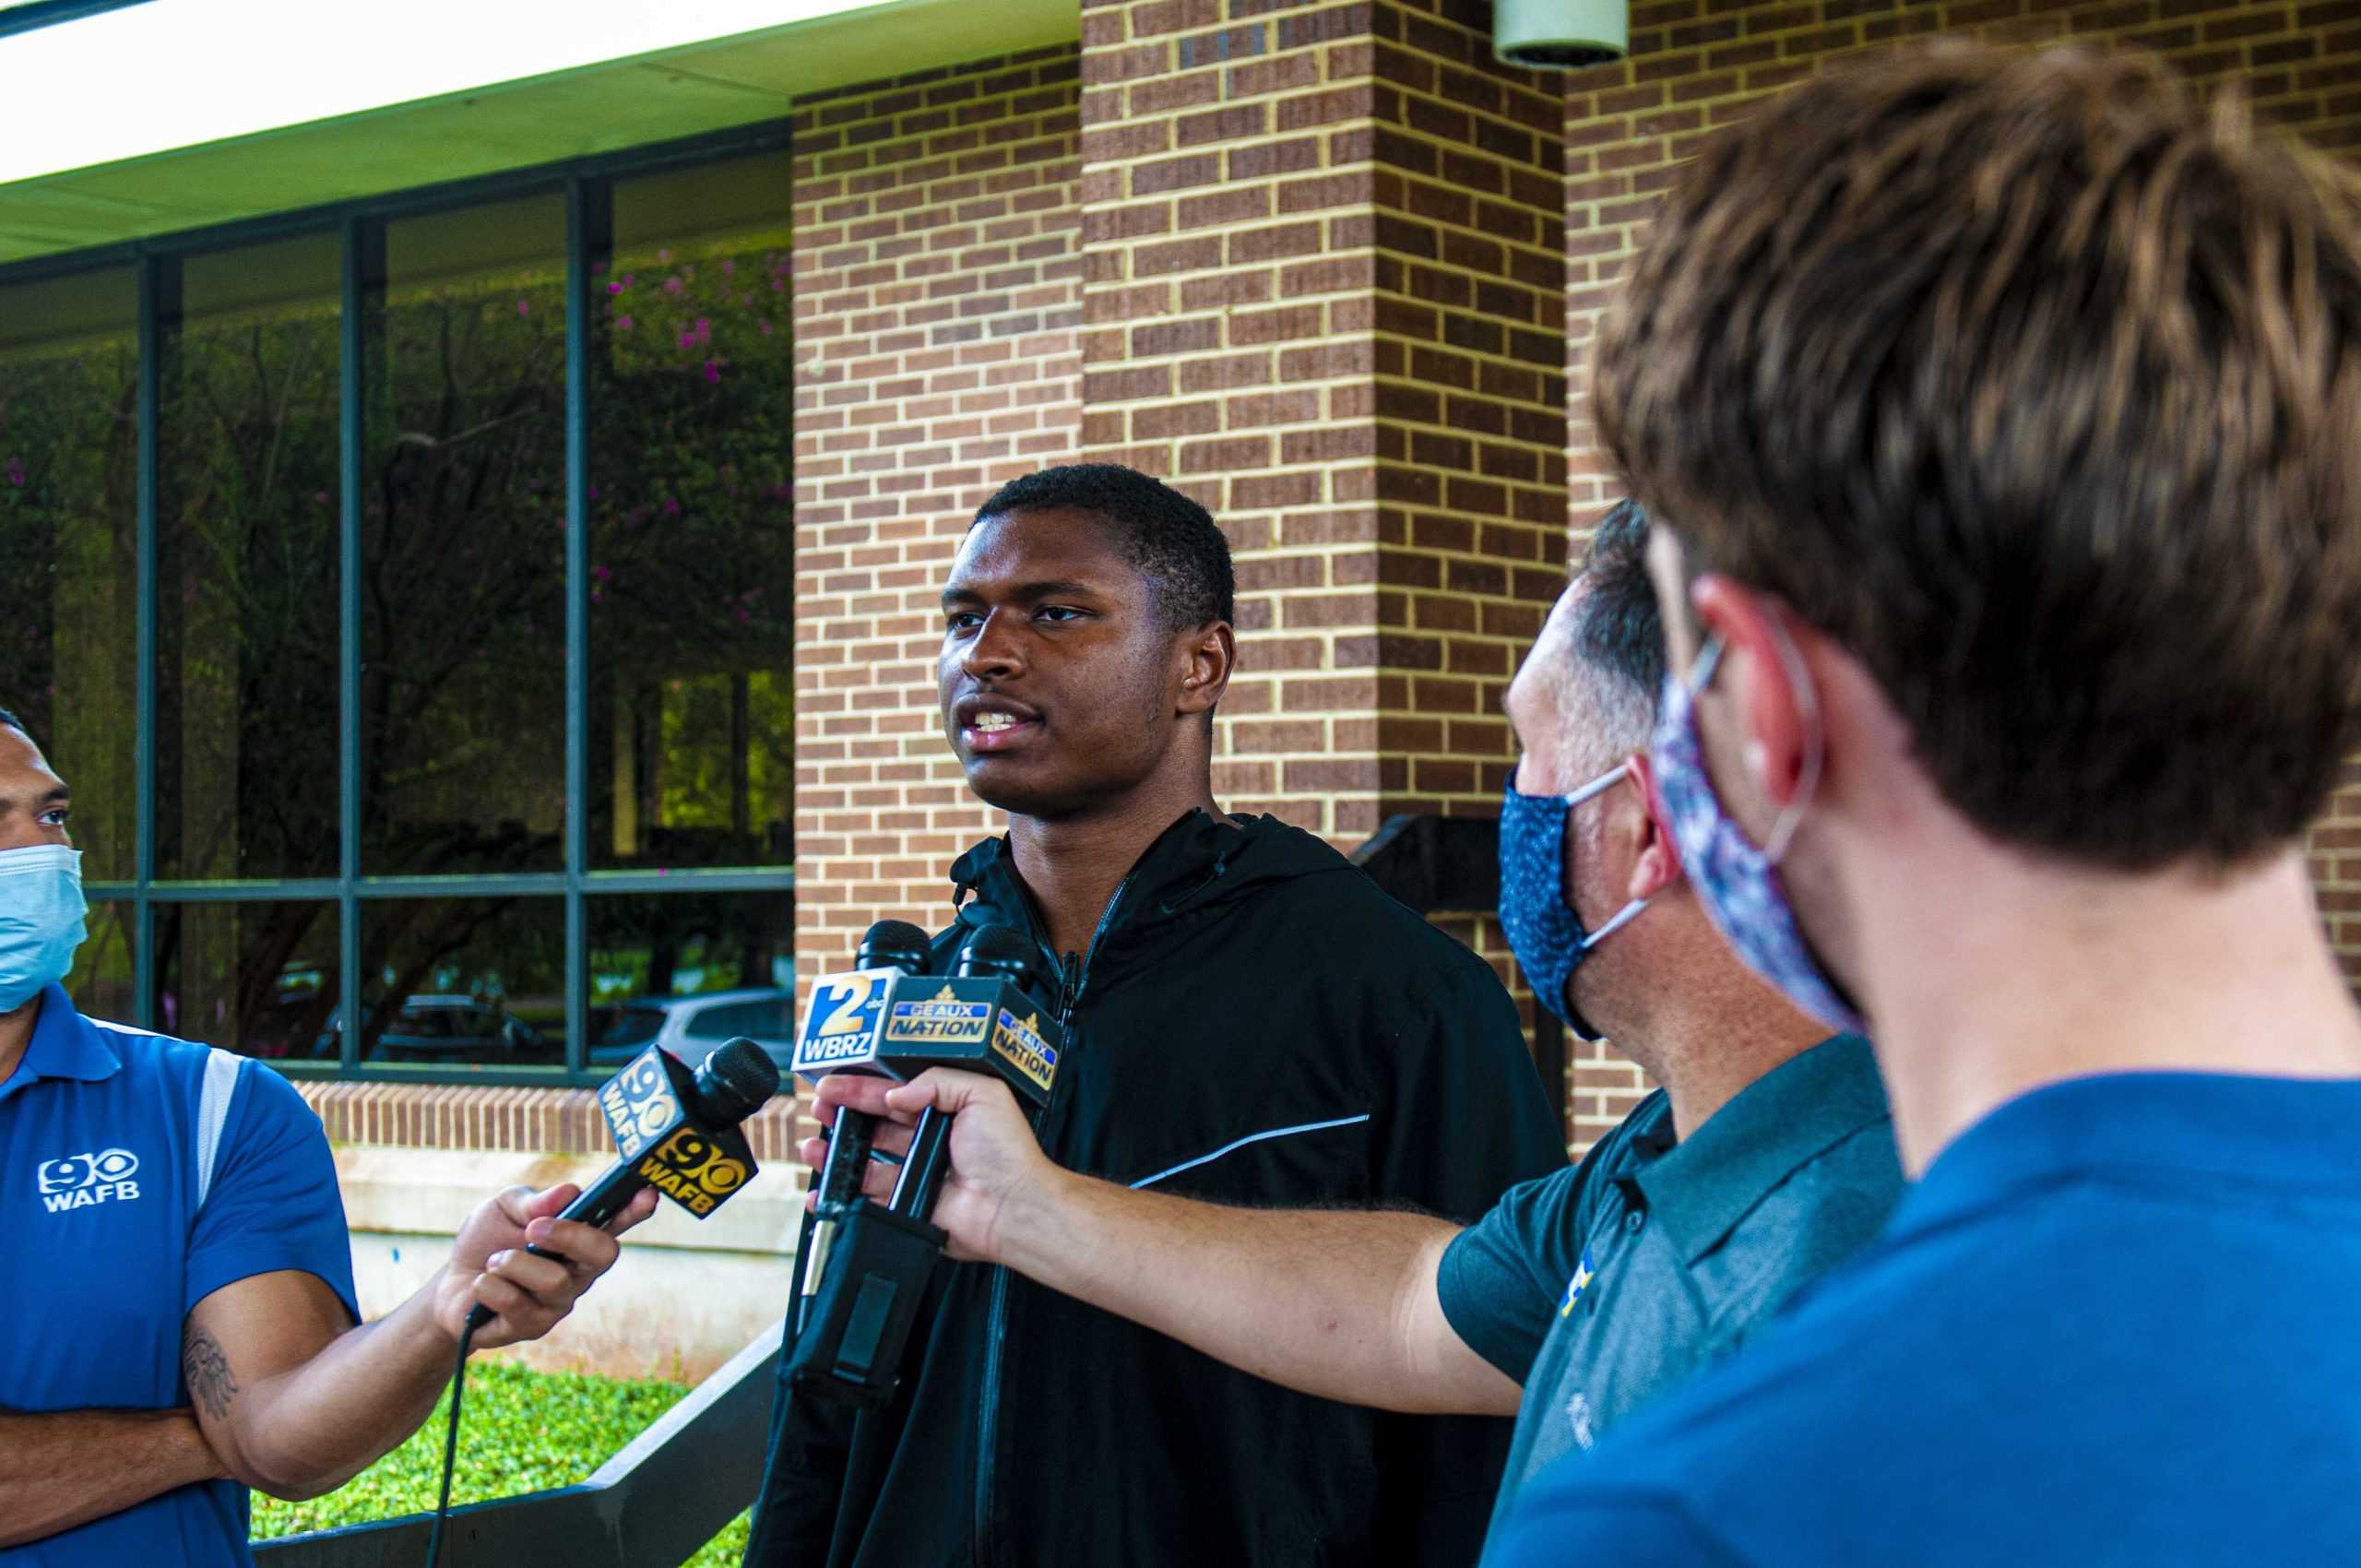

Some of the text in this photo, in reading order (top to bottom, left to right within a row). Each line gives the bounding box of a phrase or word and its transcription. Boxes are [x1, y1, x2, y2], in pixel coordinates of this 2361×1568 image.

[818, 975, 872, 1037] 2
[910, 1002, 974, 1016] GEAUX
[804, 1032, 872, 1062] WBRZ
[891, 1019, 985, 1037] NATION
[1009, 1019, 1048, 1060] GEAUX
[996, 1032, 1052, 1082] NATION
[602, 1082, 642, 1158] WAFB
[43, 1181, 140, 1213] WAFB
[638, 1157, 717, 1215] WAFB
